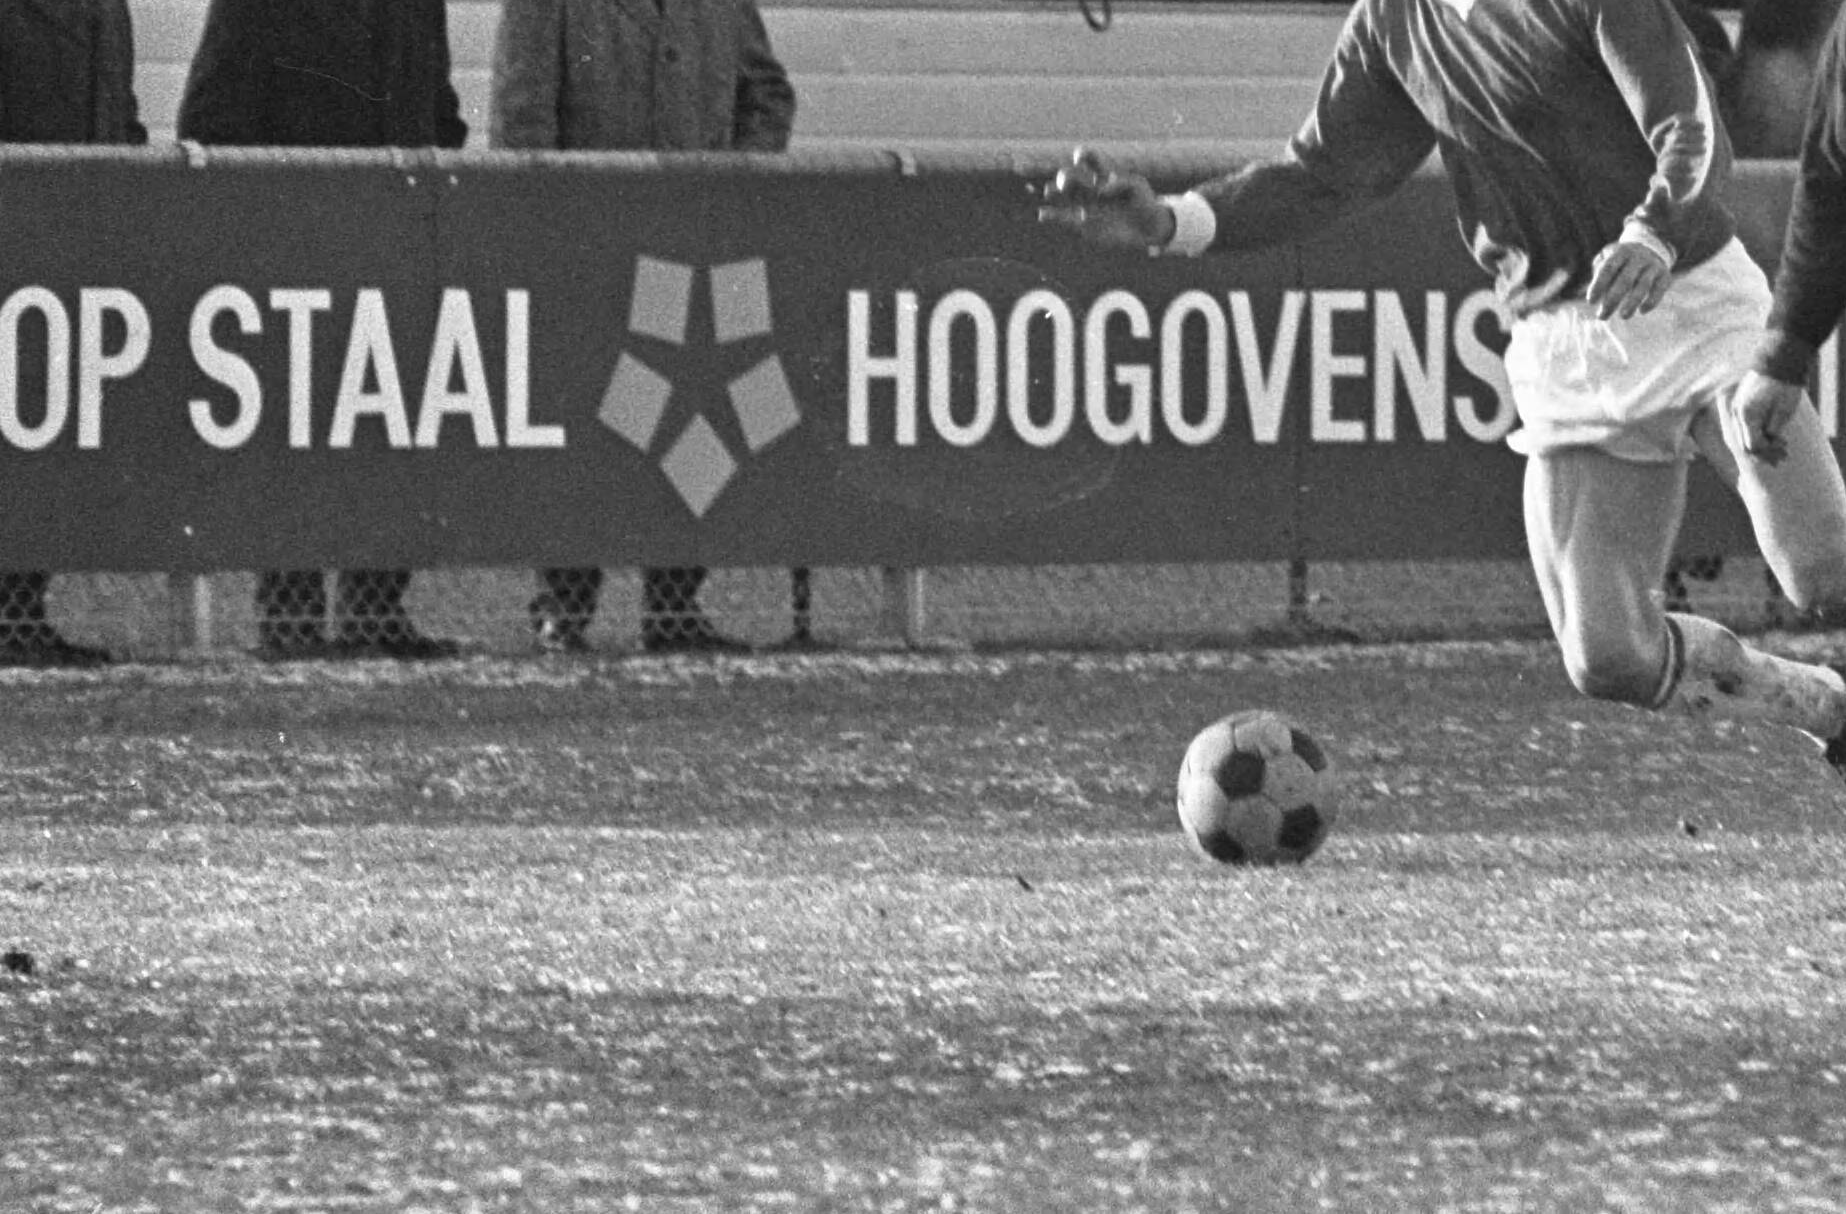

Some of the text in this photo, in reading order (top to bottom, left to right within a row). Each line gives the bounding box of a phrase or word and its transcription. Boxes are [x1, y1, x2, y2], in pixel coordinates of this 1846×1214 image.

[0, 284, 567, 451] OP STAAL
[847, 288, 1517, 447] HOOGOVENS
